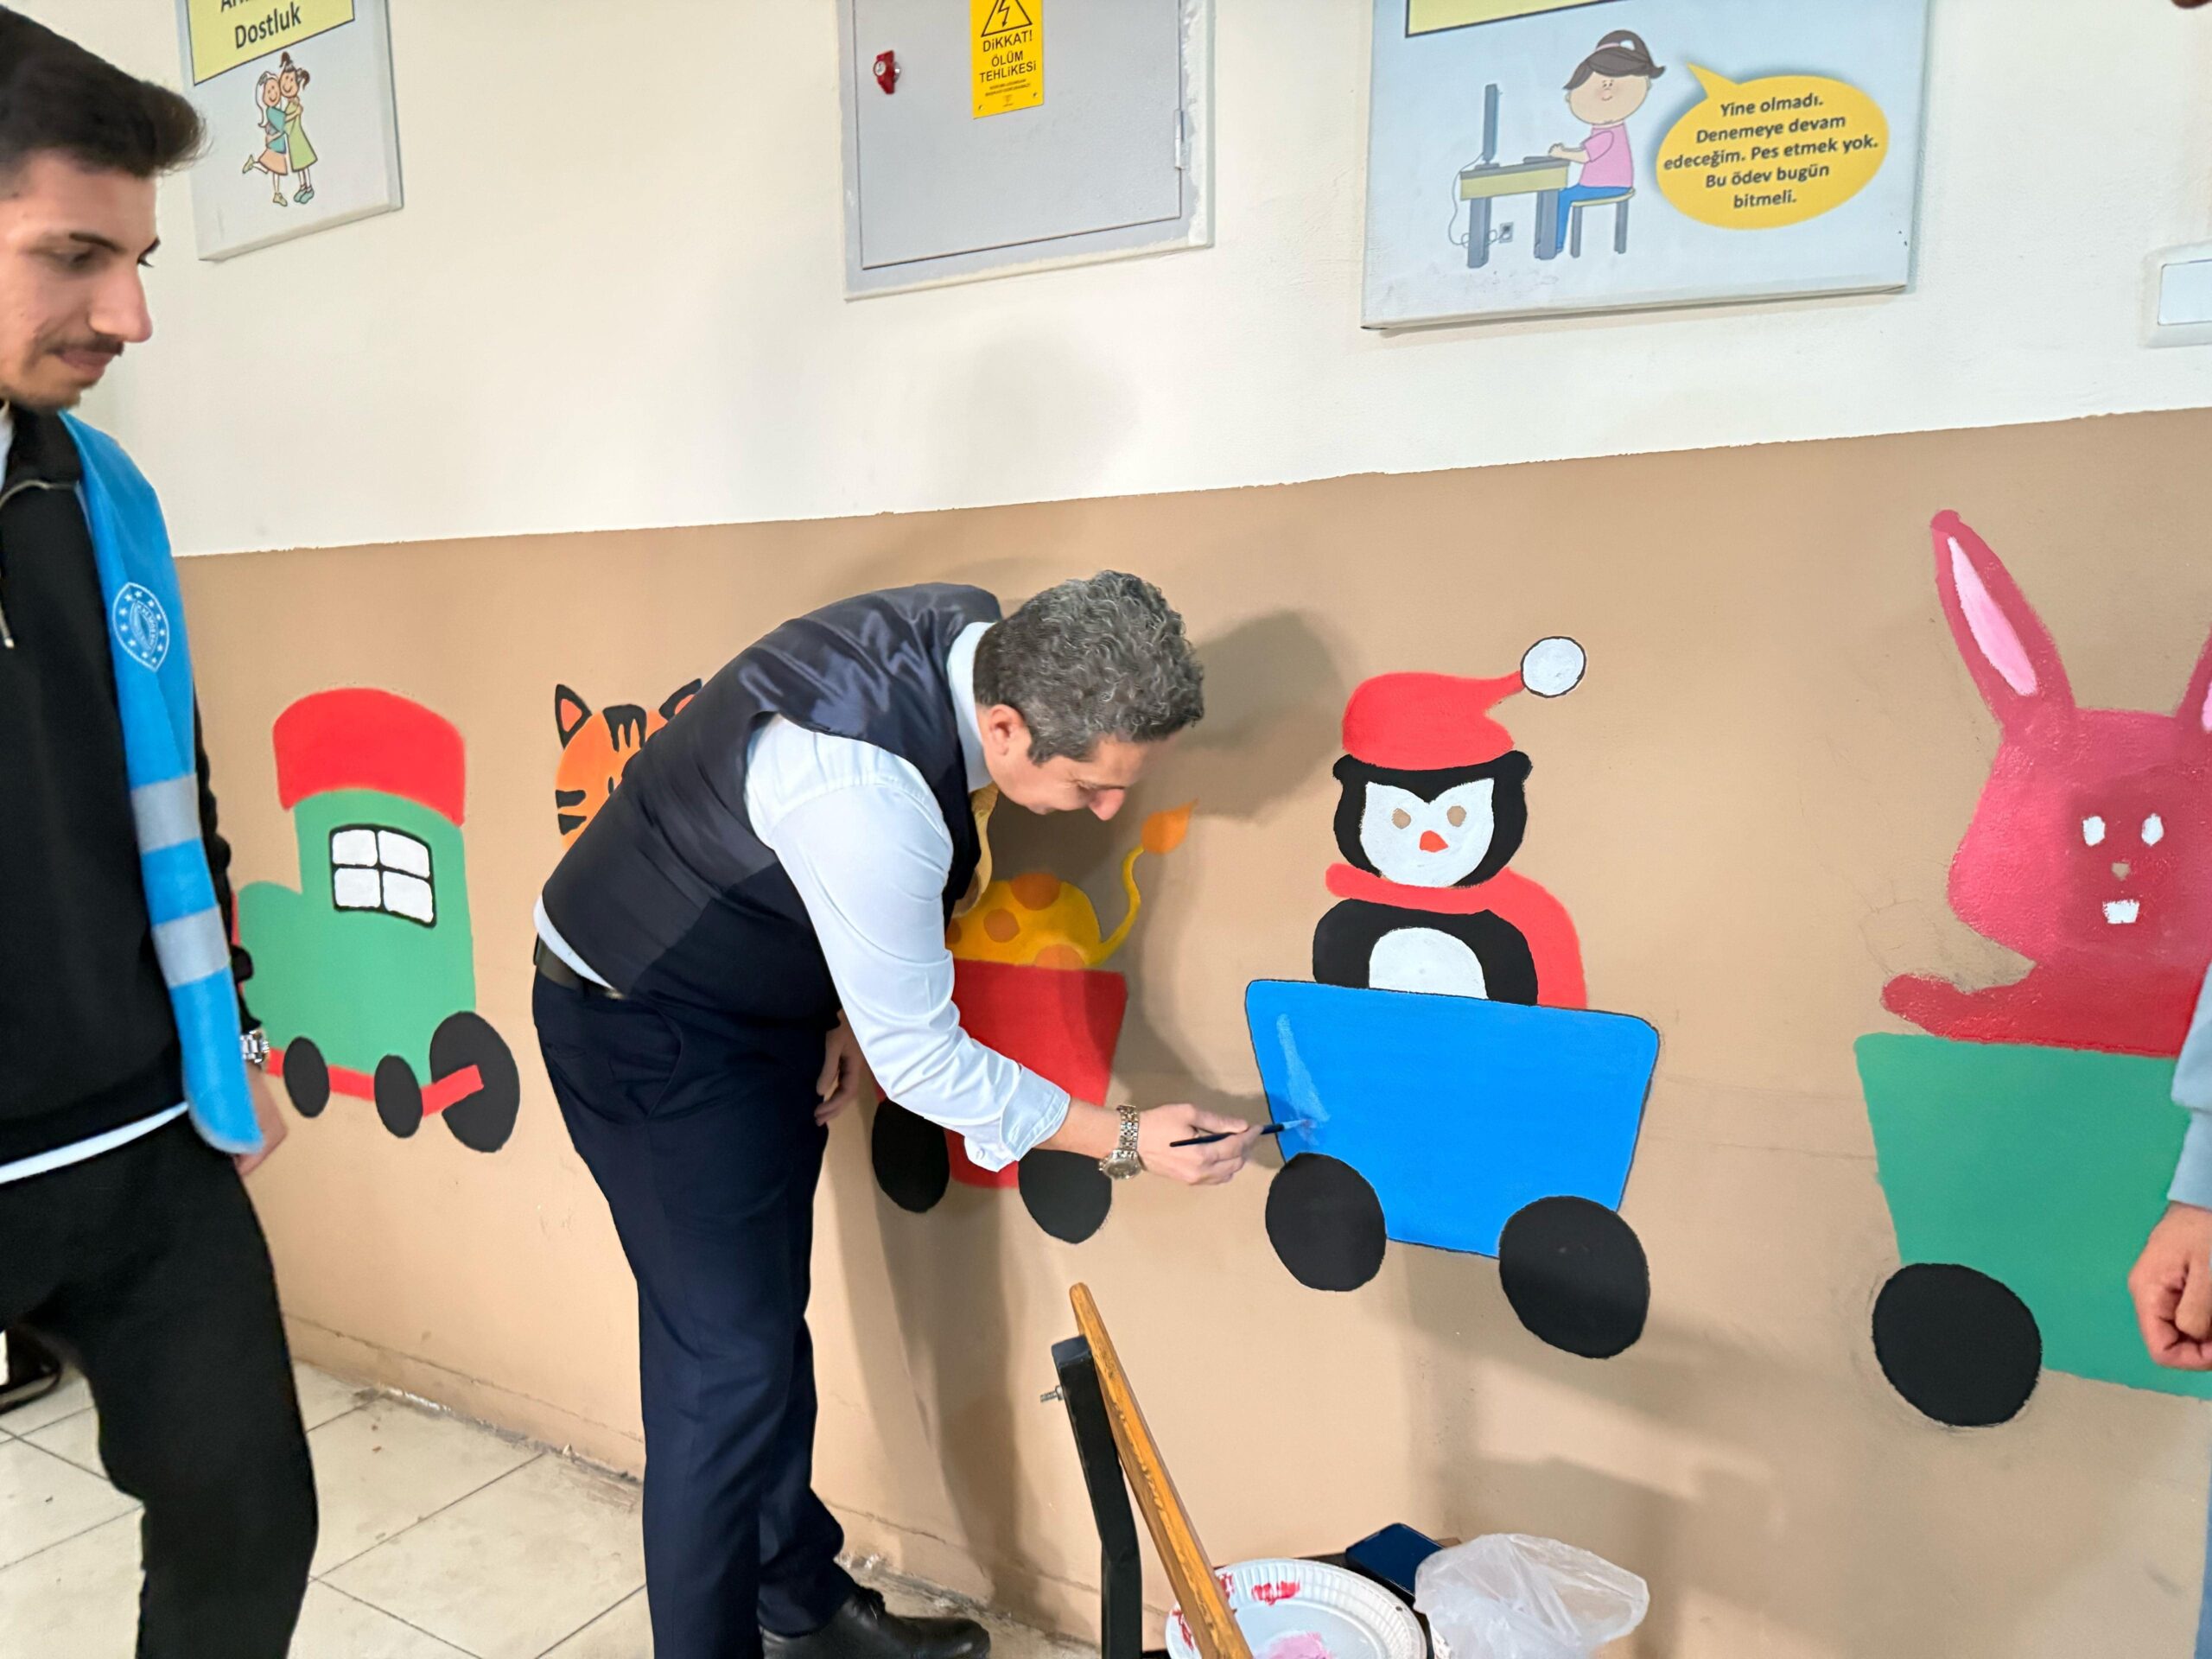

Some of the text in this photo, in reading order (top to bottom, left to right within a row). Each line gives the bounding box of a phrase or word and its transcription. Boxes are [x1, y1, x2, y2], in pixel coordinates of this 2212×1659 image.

[235, 2, 302, 49] Dostluk
[991, 50, 1023, 67] ÖLÜM
[1720, 92, 1823, 118] Yine olmadı.
[1696, 116, 1846, 143] Denemeye devam
[1663, 134, 1878, 170] edeceğim. Pes etmek yok.
[1706, 164, 1829, 188] Bu ödev bugün
[1733, 189, 1797, 209] bitmeli.
